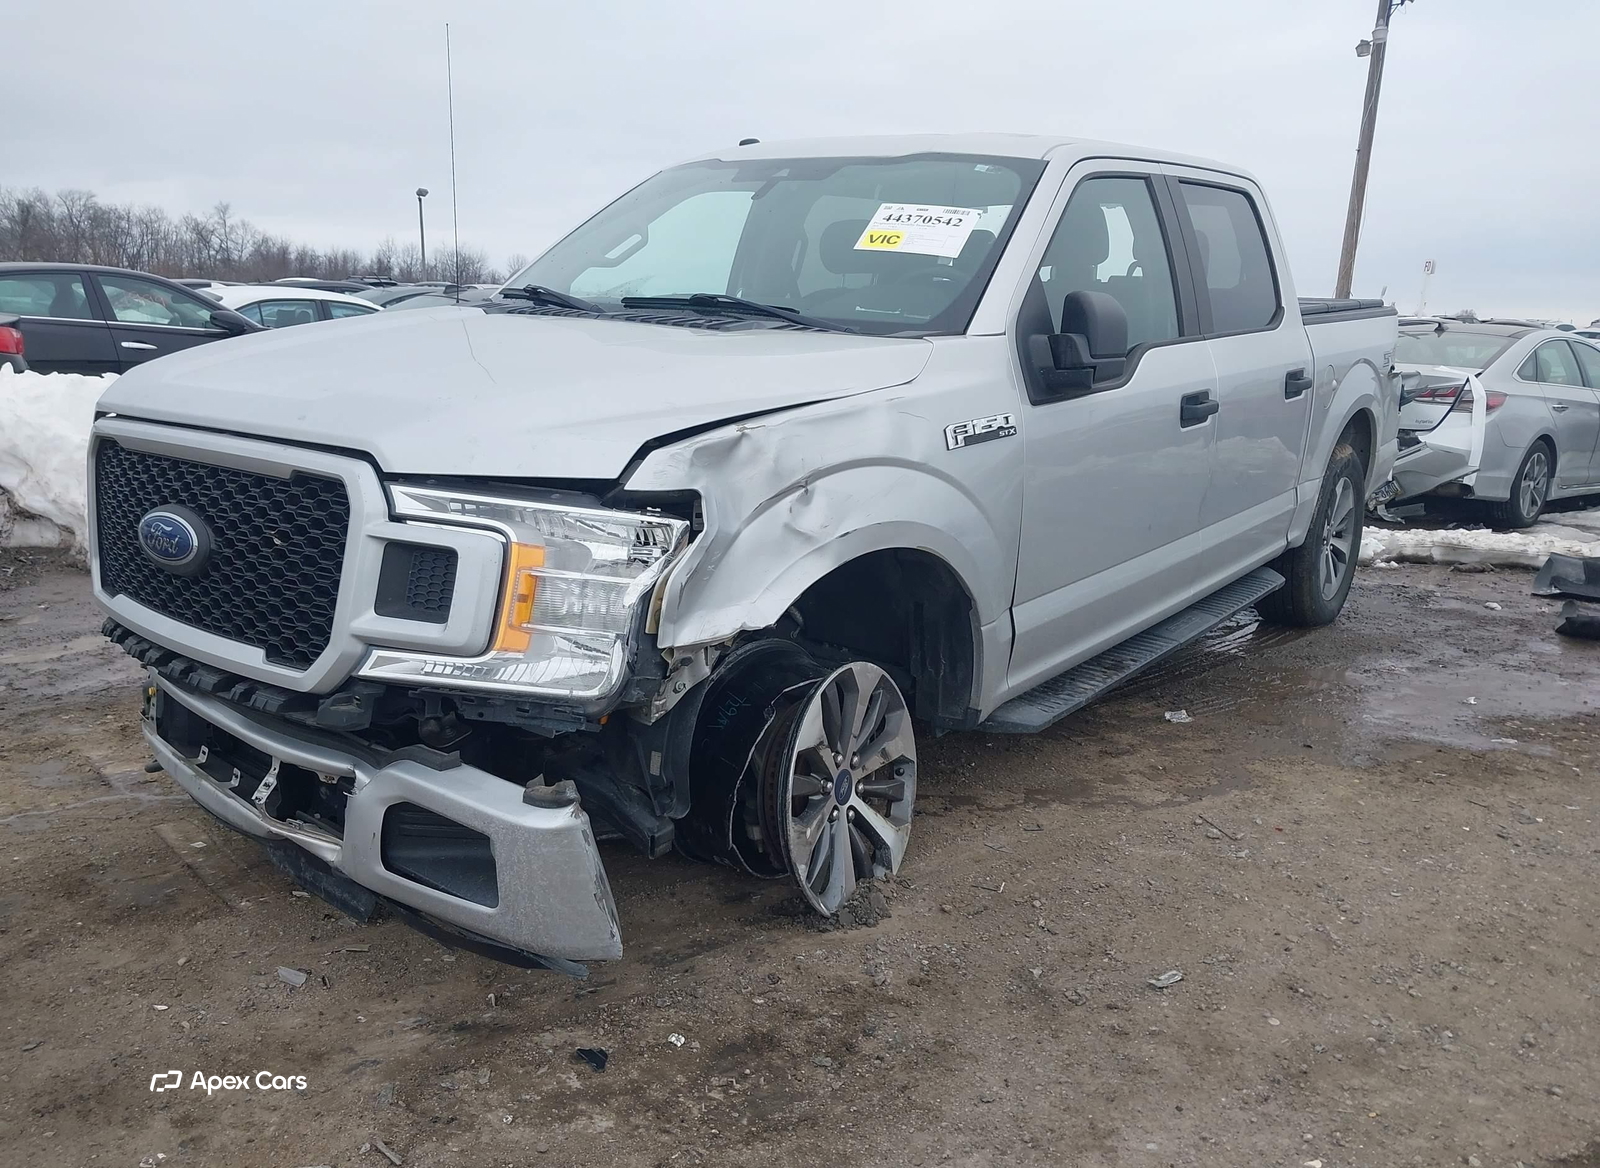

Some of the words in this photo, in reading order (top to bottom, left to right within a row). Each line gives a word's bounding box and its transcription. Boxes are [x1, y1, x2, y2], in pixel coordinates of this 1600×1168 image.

[882, 213, 963, 227] 44370542
[869, 234, 901, 245] VIC
[999, 427, 1016, 437] STX
[147, 521, 180, 554] Ford
